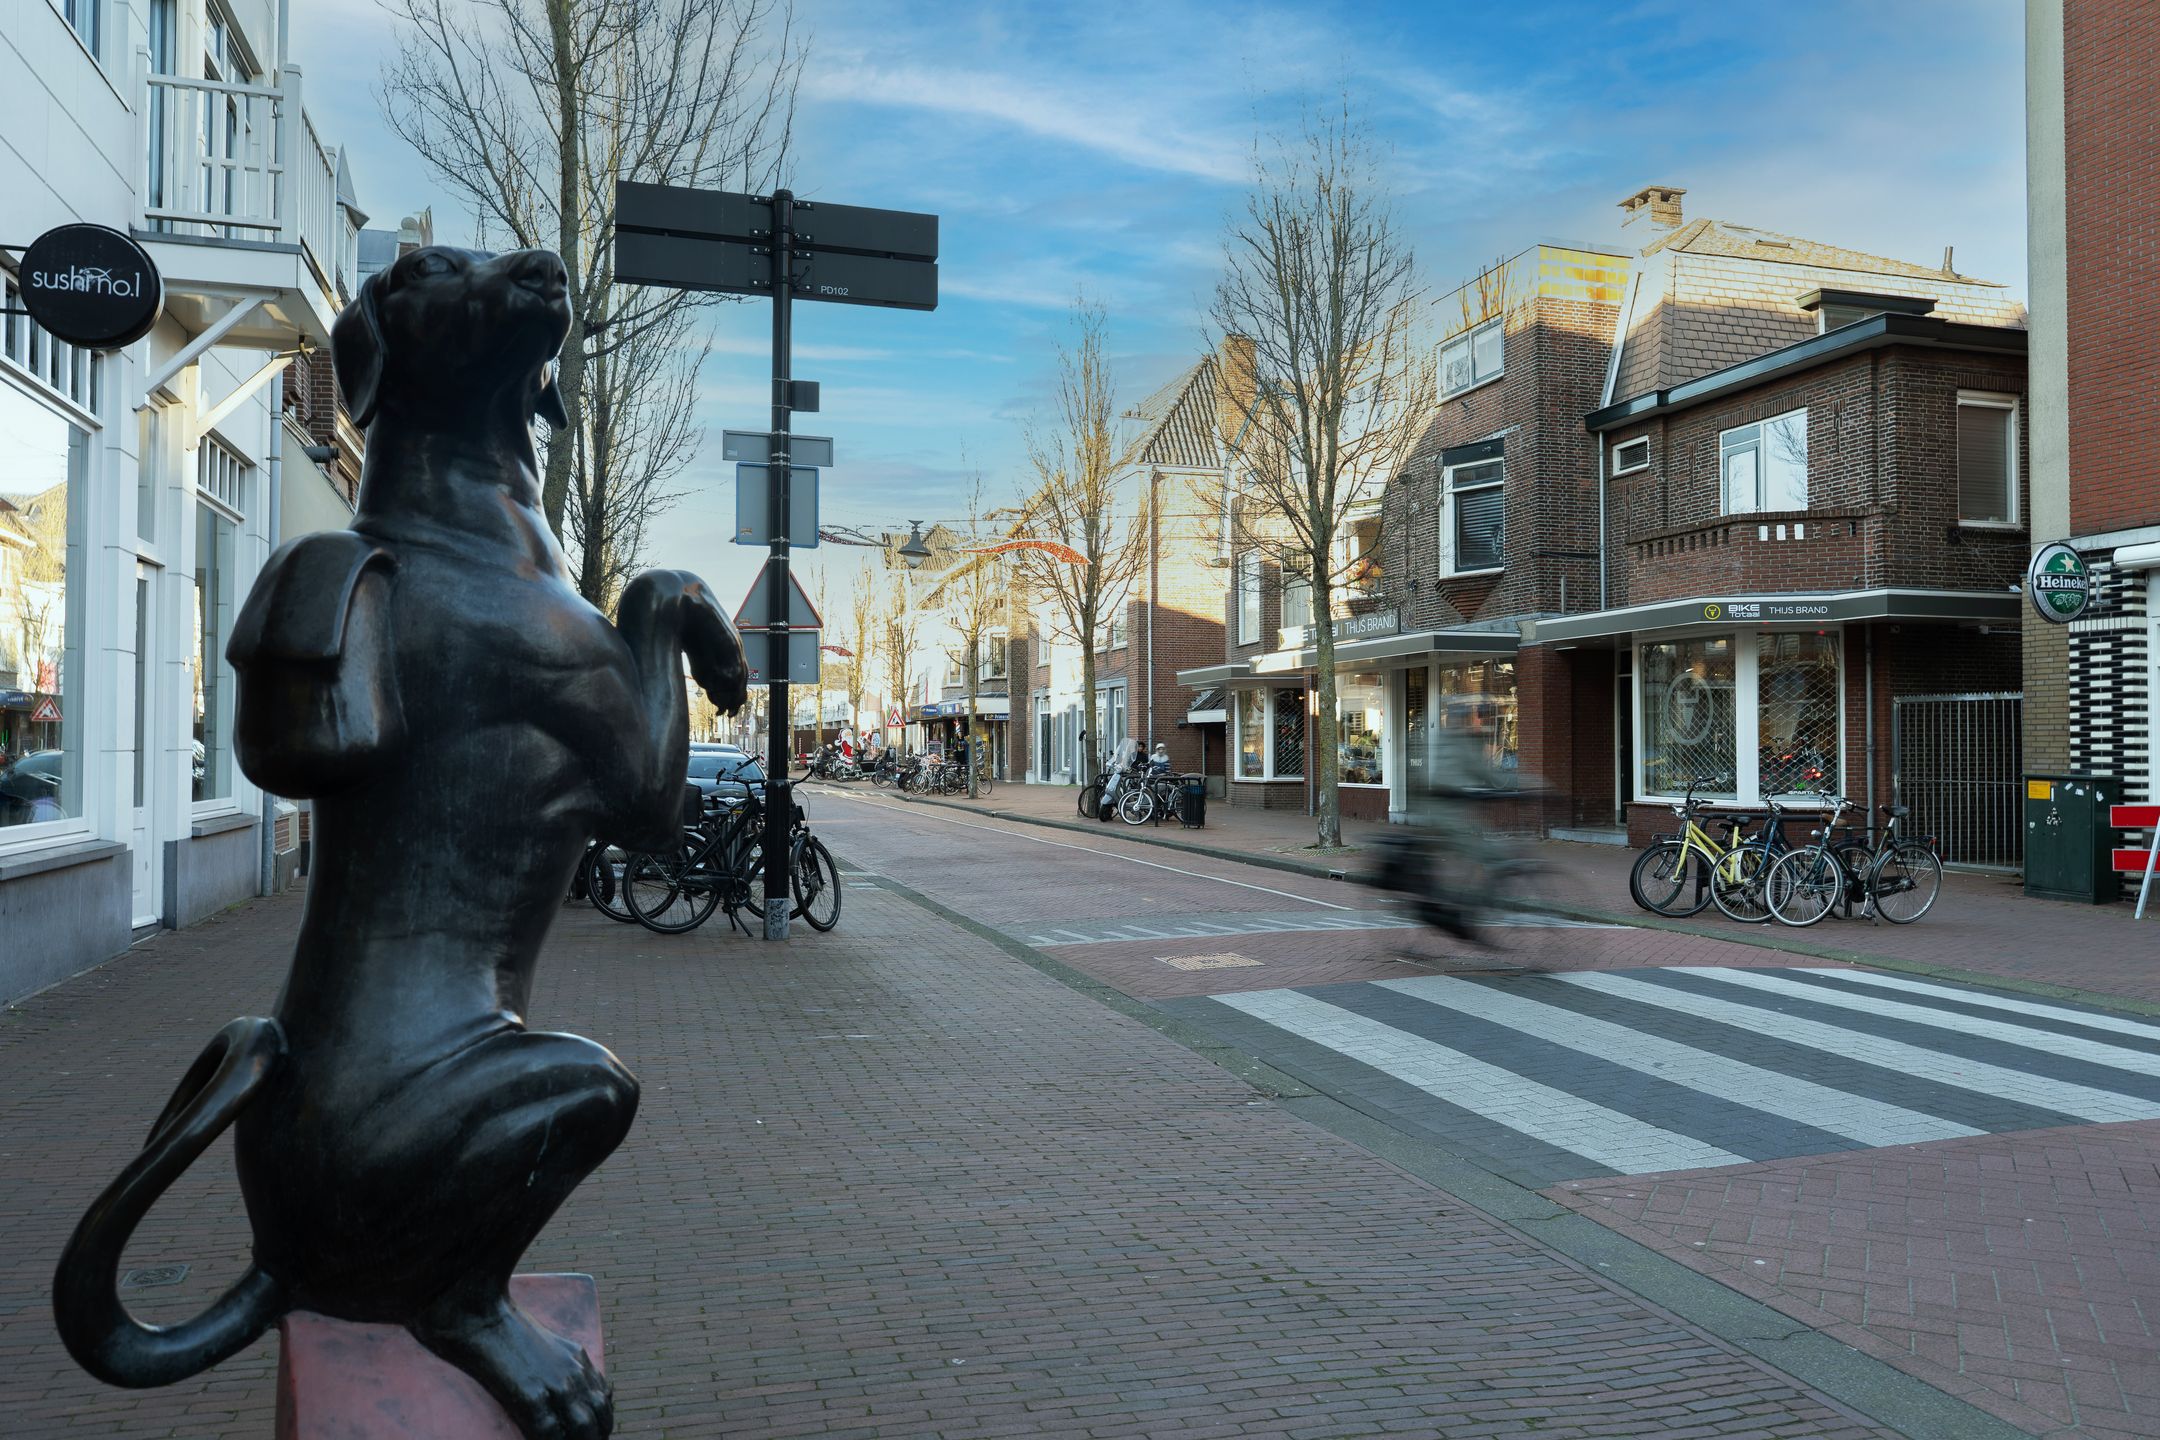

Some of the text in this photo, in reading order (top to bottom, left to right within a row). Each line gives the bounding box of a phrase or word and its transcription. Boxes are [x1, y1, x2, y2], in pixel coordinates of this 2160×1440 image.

[32, 264, 140, 298] sushi no.1
[820, 285, 849, 296] PD102
[1728, 603, 1760, 612] BIKE
[1768, 606, 1828, 615] THIJS BRAND
[1345, 617, 1366, 635] THIJS
[1367, 614, 1396, 632] BRAND
